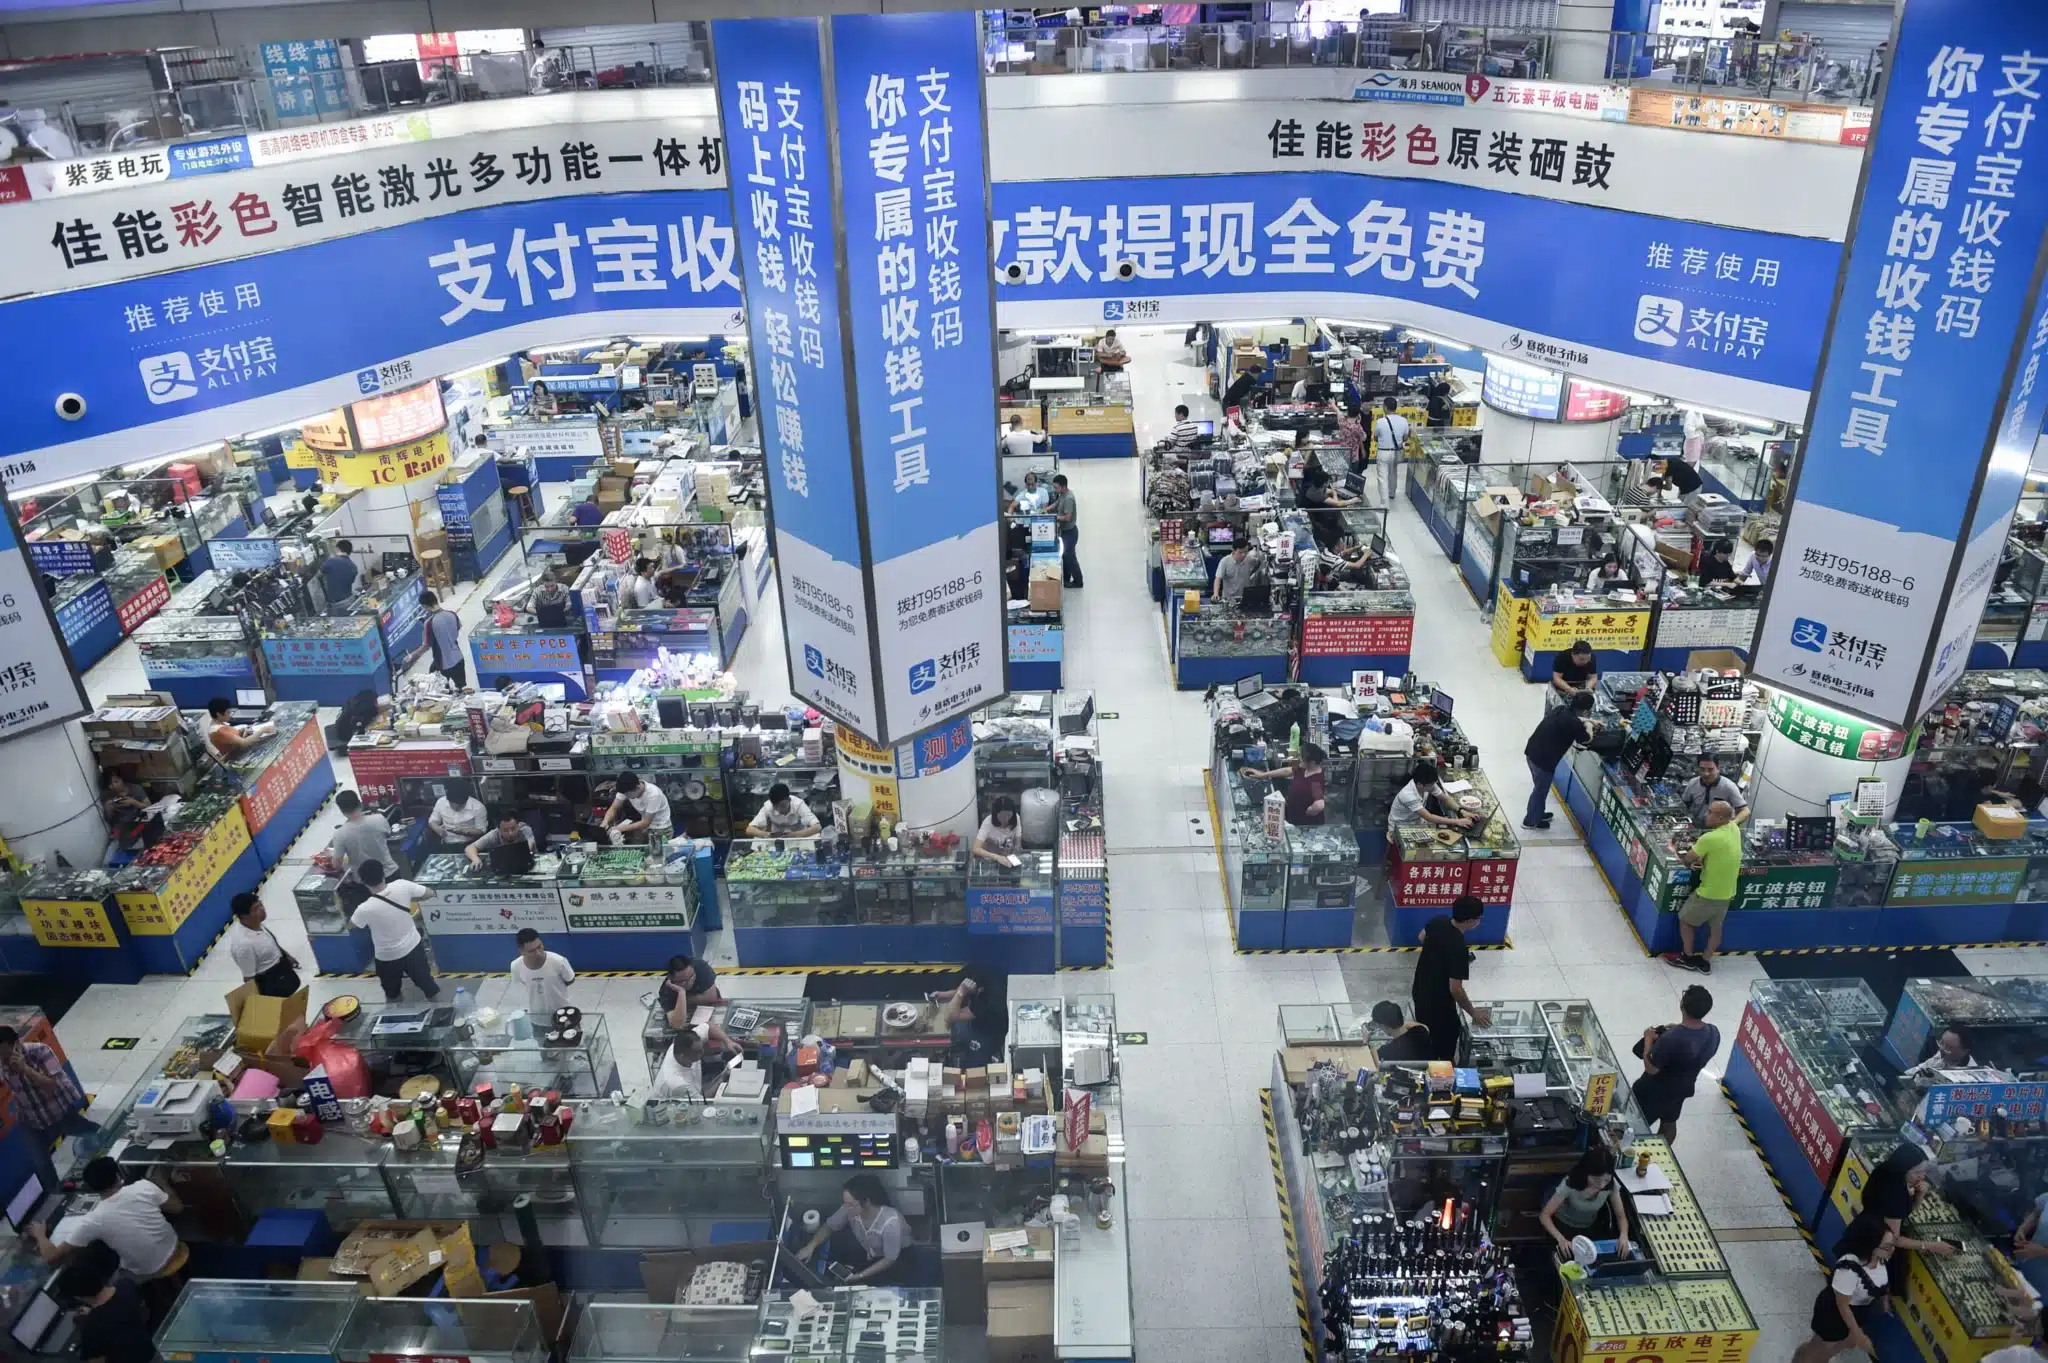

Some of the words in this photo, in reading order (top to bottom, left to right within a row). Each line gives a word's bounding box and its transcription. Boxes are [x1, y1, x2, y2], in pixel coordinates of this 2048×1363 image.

[1420, 80, 1462, 93] SEAMOON
[1492, 85, 1600, 111] 五元素平板电脑
[1267, 118, 1616, 191] 佳能彩色原装硒鼓
[65, 153, 164, 187] 紫菱电玩
[1935, 50, 2048, 339] 支付宝收钱码
[916, 67, 963, 350] 支付宝收钱码
[774, 82, 824, 369] 支付宝收钱码
[1840, 45, 1985, 457] 你专属的收钱工具
[429, 212, 742, 326] 支付宝收
[1646, 242, 1781, 288] 推荐使用
[738, 80, 786, 293] 码上收钱
[764, 307, 808, 499] 轻松赚钱
[865, 74, 930, 494] 你专属的收钱工具
[124, 282, 262, 333] 推荐使用
[1125, 300, 1160, 313] 支付宝
[1127, 312, 1160, 320] ALIPAY
[1685, 306, 1769, 346] 支付宝
[195, 336, 277, 377] 支付宝
[1686, 334, 1762, 361] ALIPAY
[207, 361, 278, 390] ALIPAY
[380, 359, 412, 380] 支付宝
[383, 374, 413, 387] ALIPAY
[370, 467, 398, 485] IC
[1802, 546, 1916, 592] 拨打95188-6
[793, 575, 855, 619] 拨打95188-6
[897, 570, 983, 616] 拨打95188-6
[1798, 566, 1910, 608] 为您免费寄送收钱码
[898, 590, 984, 632] 为您免费寄送收钱码
[1552, 615, 1639, 628] 环球电子
[1575, 627, 1636, 635] ELECTRONICS
[939, 642, 981, 673] 支付宝
[1828, 629, 1888, 662] 支付宝
[1828, 647, 1882, 671] ALIPAY
[824, 658, 857, 689] 支付宝
[941, 657, 981, 682] ALIPAY
[0, 677, 37, 697] IPAY
[827, 675, 858, 698] ALIPAY
[1359, 674, 1376, 697] 电池
[1791, 708, 1850, 740] 红波按钮
[924, 720, 968, 764] 测试
[1786, 723, 1846, 756] 厂家直销
[875, 785, 893, 811] 电池
[1408, 866, 1445, 878] 各系列
[1449, 866, 1463, 877] IC
[1480, 875, 1506, 884] 电容
[1482, 864, 1507, 873] 电阻
[1403, 883, 1463, 896] 名牌连接器
[1477, 896, 1508, 904] 业配套
[1743, 881, 1826, 895] 红波按钮
[1740, 895, 1823, 910] 厂家直销
[1950, 1087, 1992, 1101] 激光头
[1947, 1105, 1966, 1117] IC
[1637, 1334, 1744, 1350] 拓欣电子
